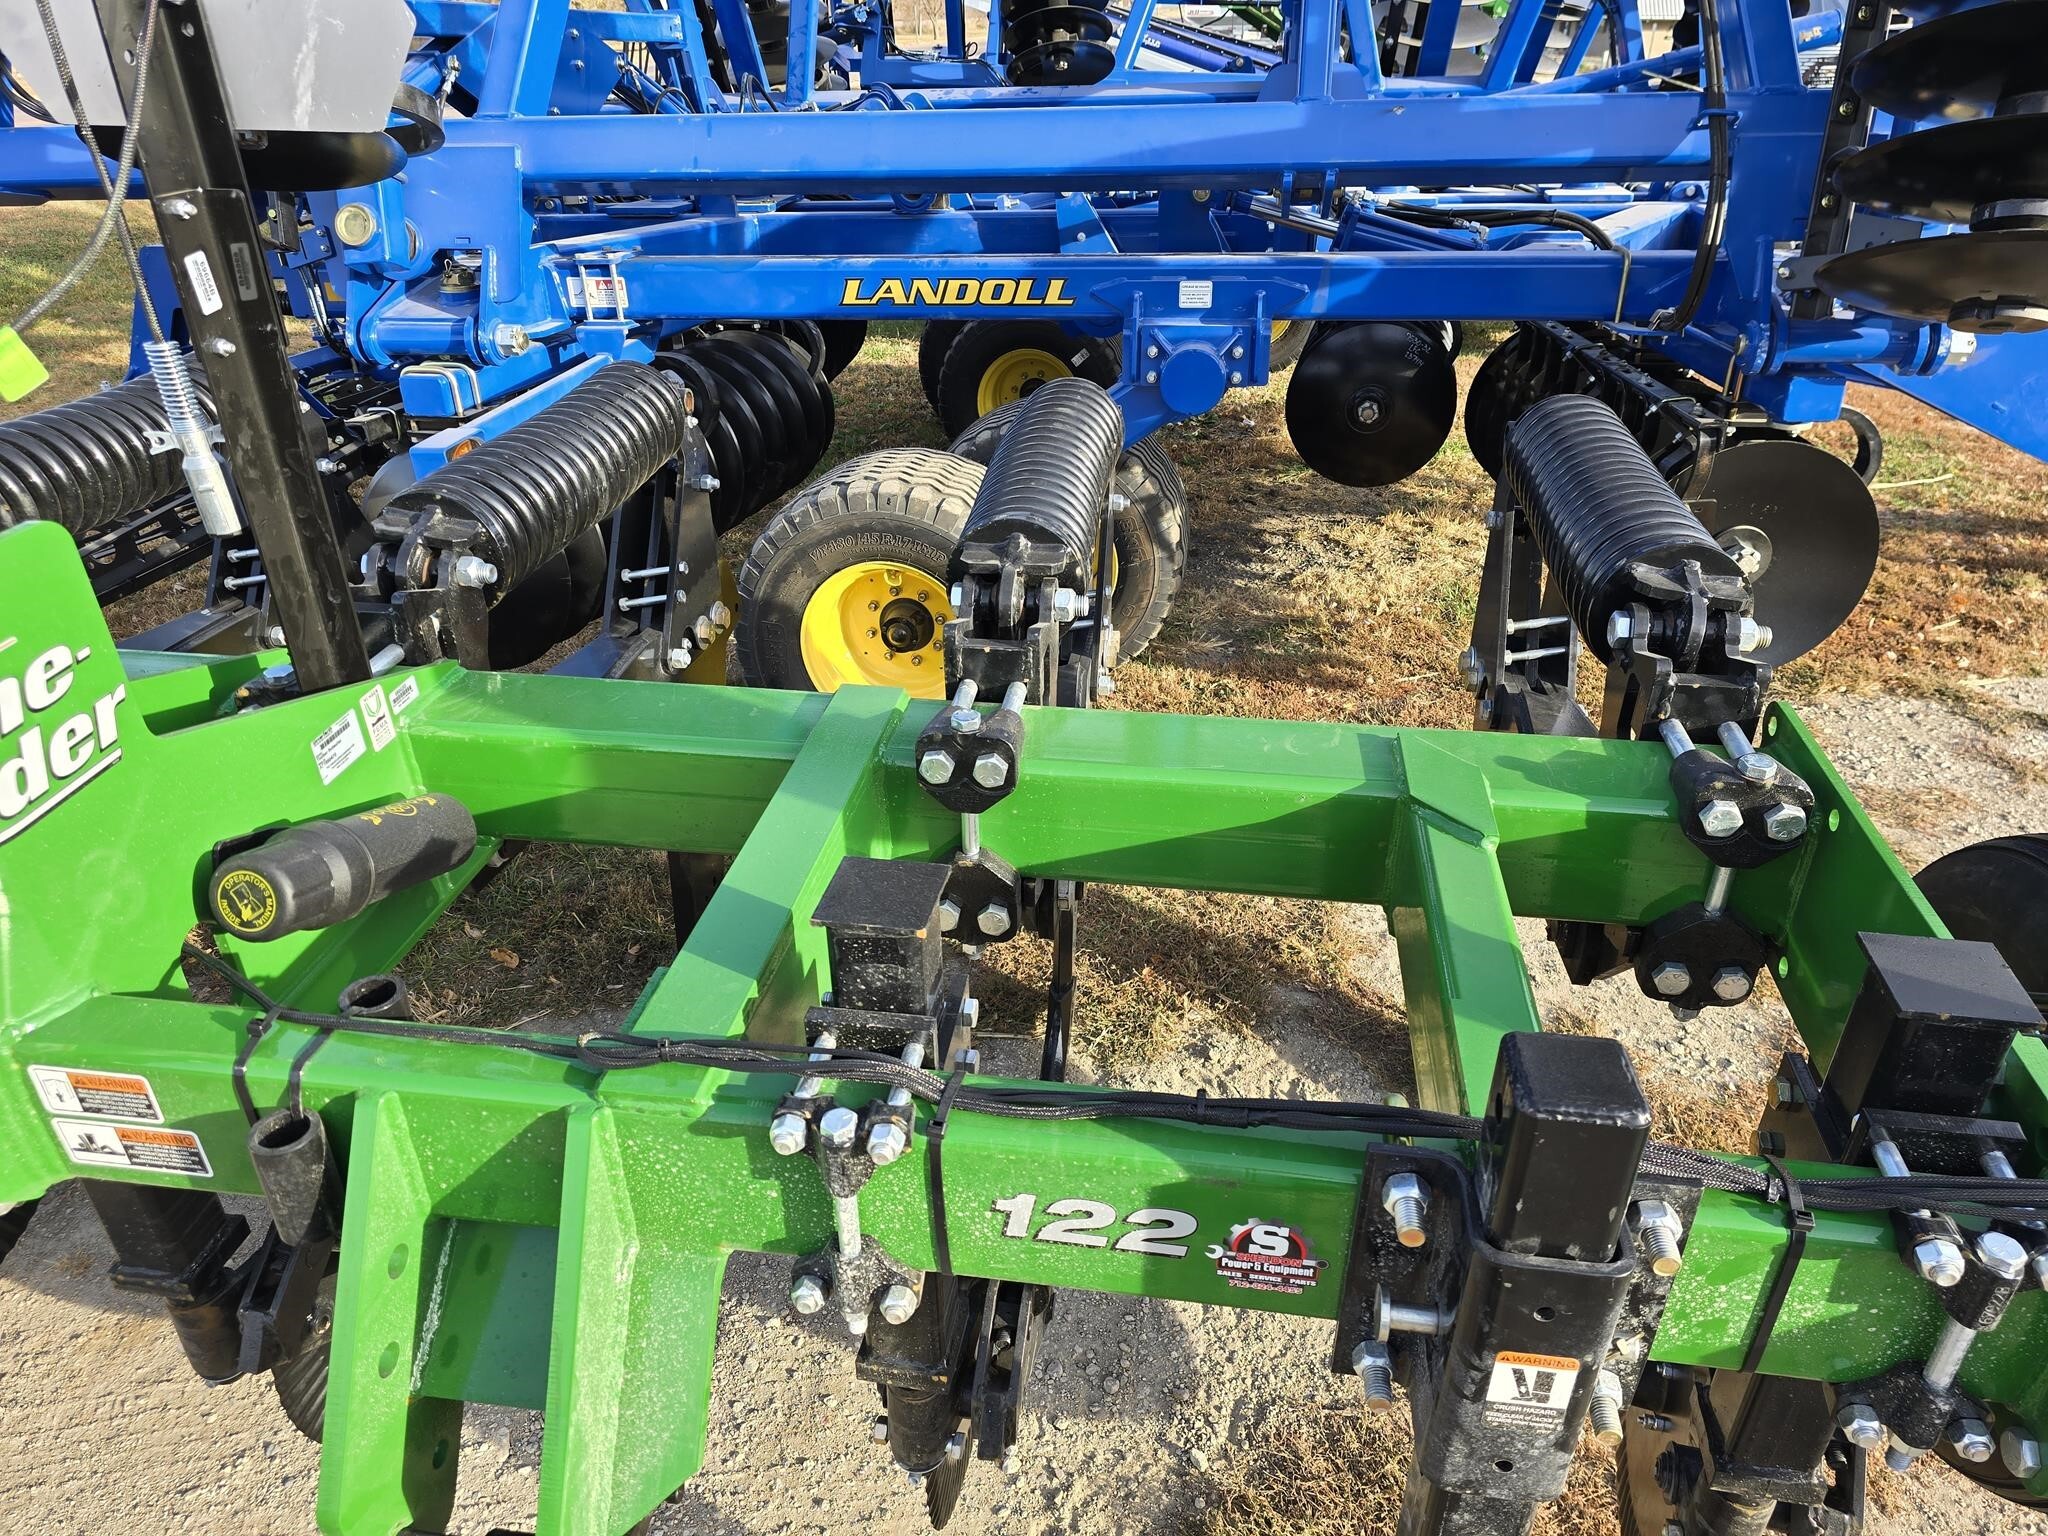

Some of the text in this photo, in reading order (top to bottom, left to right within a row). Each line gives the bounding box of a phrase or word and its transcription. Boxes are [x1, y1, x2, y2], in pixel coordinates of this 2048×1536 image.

[839, 278, 1077, 306] LANDOLL
[225, 874, 273, 927] OPERATOR'S MANUAL
[221, 899, 241, 926] INSIDE
[87, 1076, 144, 1091] WARNING
[133, 1130, 193, 1146] WARNING
[990, 1193, 1198, 1259] 122
[1248, 1224, 1290, 1257] S
[1221, 1257, 1314, 1277] Power & Equipment
[1235, 1252, 1303, 1267] SHELDON
[1216, 1269, 1242, 1277] SALES
[1249, 1273, 1282, 1282] SERVICE
[1289, 1278, 1317, 1287] PARTS
[1512, 1355, 1577, 1369] WARNING
[1493, 1404, 1557, 1416] CRUSH HAZARD
